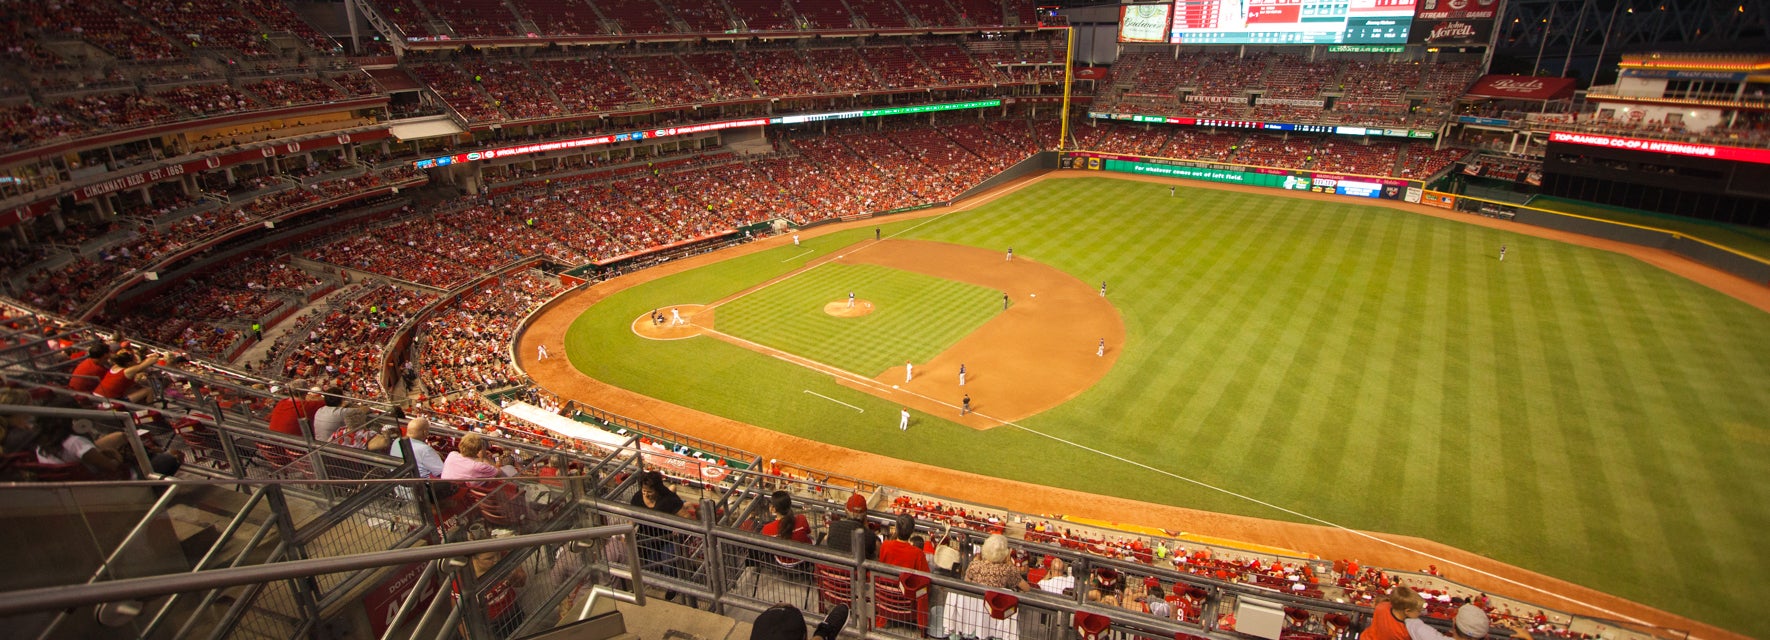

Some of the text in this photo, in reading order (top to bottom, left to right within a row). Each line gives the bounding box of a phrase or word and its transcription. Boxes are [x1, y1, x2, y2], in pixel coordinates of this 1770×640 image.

[1424, 25, 1473, 41] Morrell
[1555, 133, 1716, 156] TOP-RANKED CO-OP & INTERNSHIPS
[84, 179, 126, 197] CINCINNATI
[167, 164, 184, 176] 1869
[1145, 166, 1172, 174] whatever
[388, 570, 416, 594] DOWN
